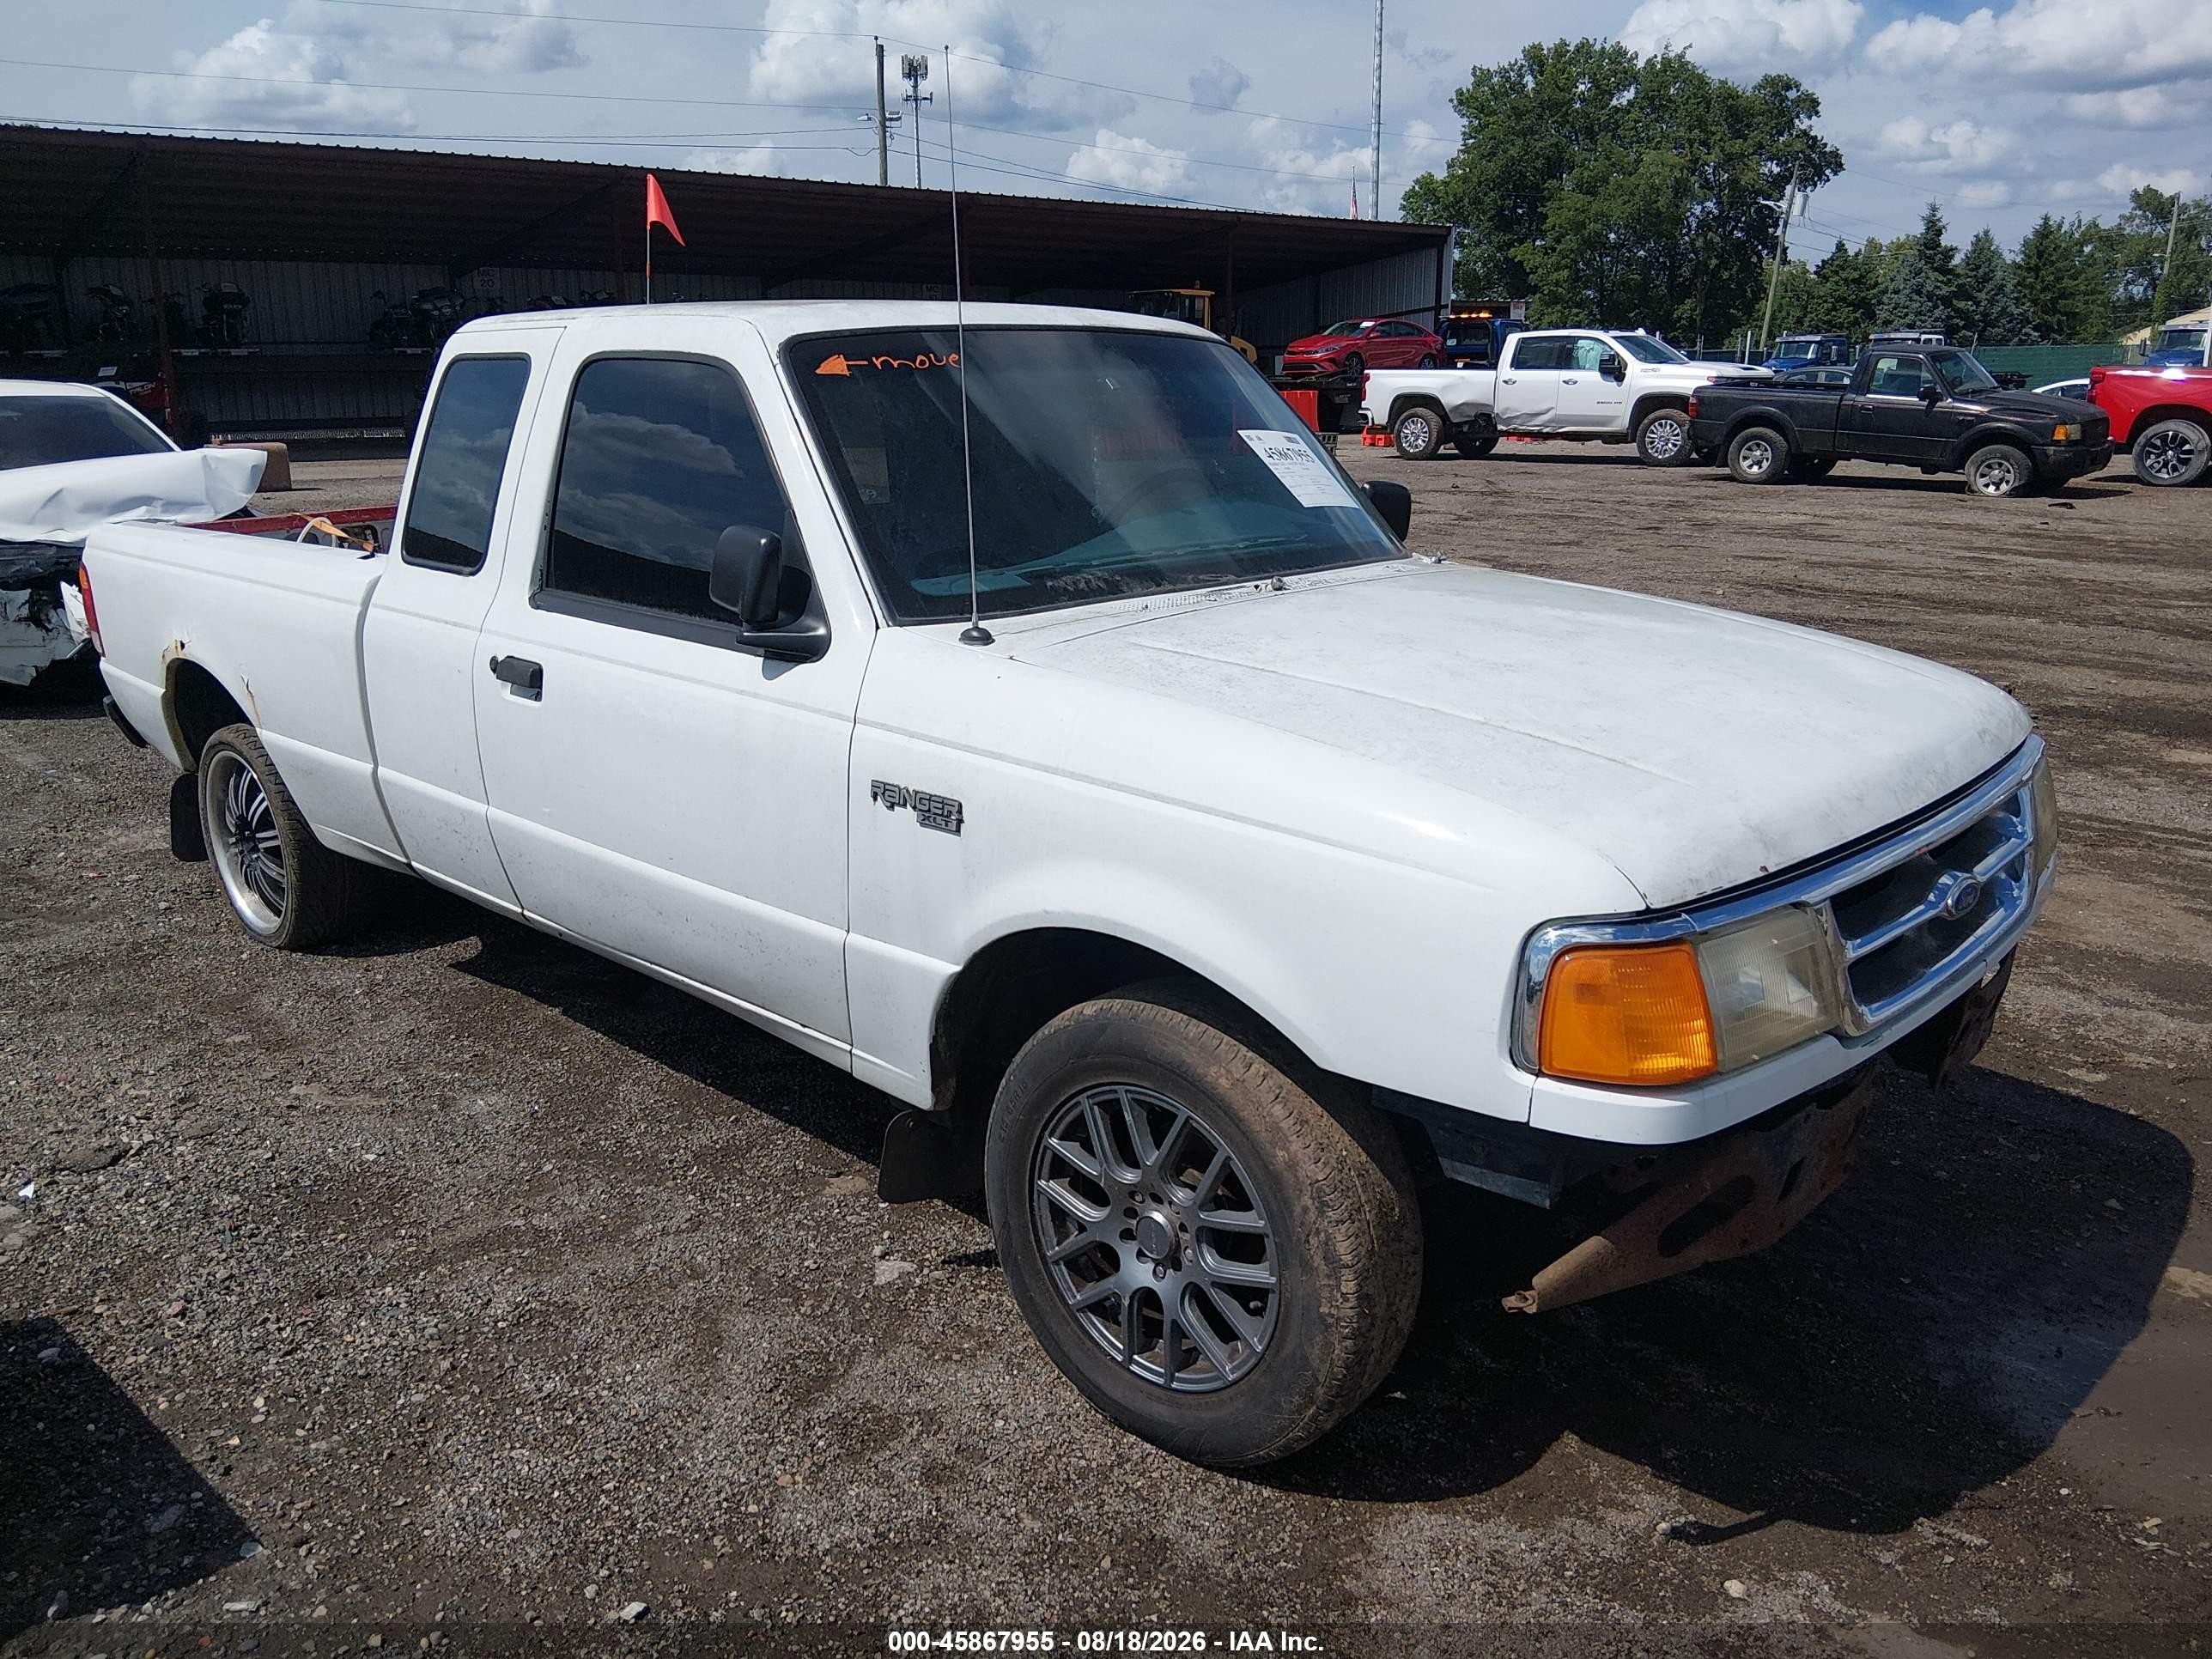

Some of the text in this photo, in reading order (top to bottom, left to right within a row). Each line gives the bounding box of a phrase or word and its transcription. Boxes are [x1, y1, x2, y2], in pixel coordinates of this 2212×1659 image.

[480, 278, 495, 288] 20
[872, 352, 961, 370] move
[1263, 447, 1316, 464] 45867955
[921, 813, 953, 828] XLT
